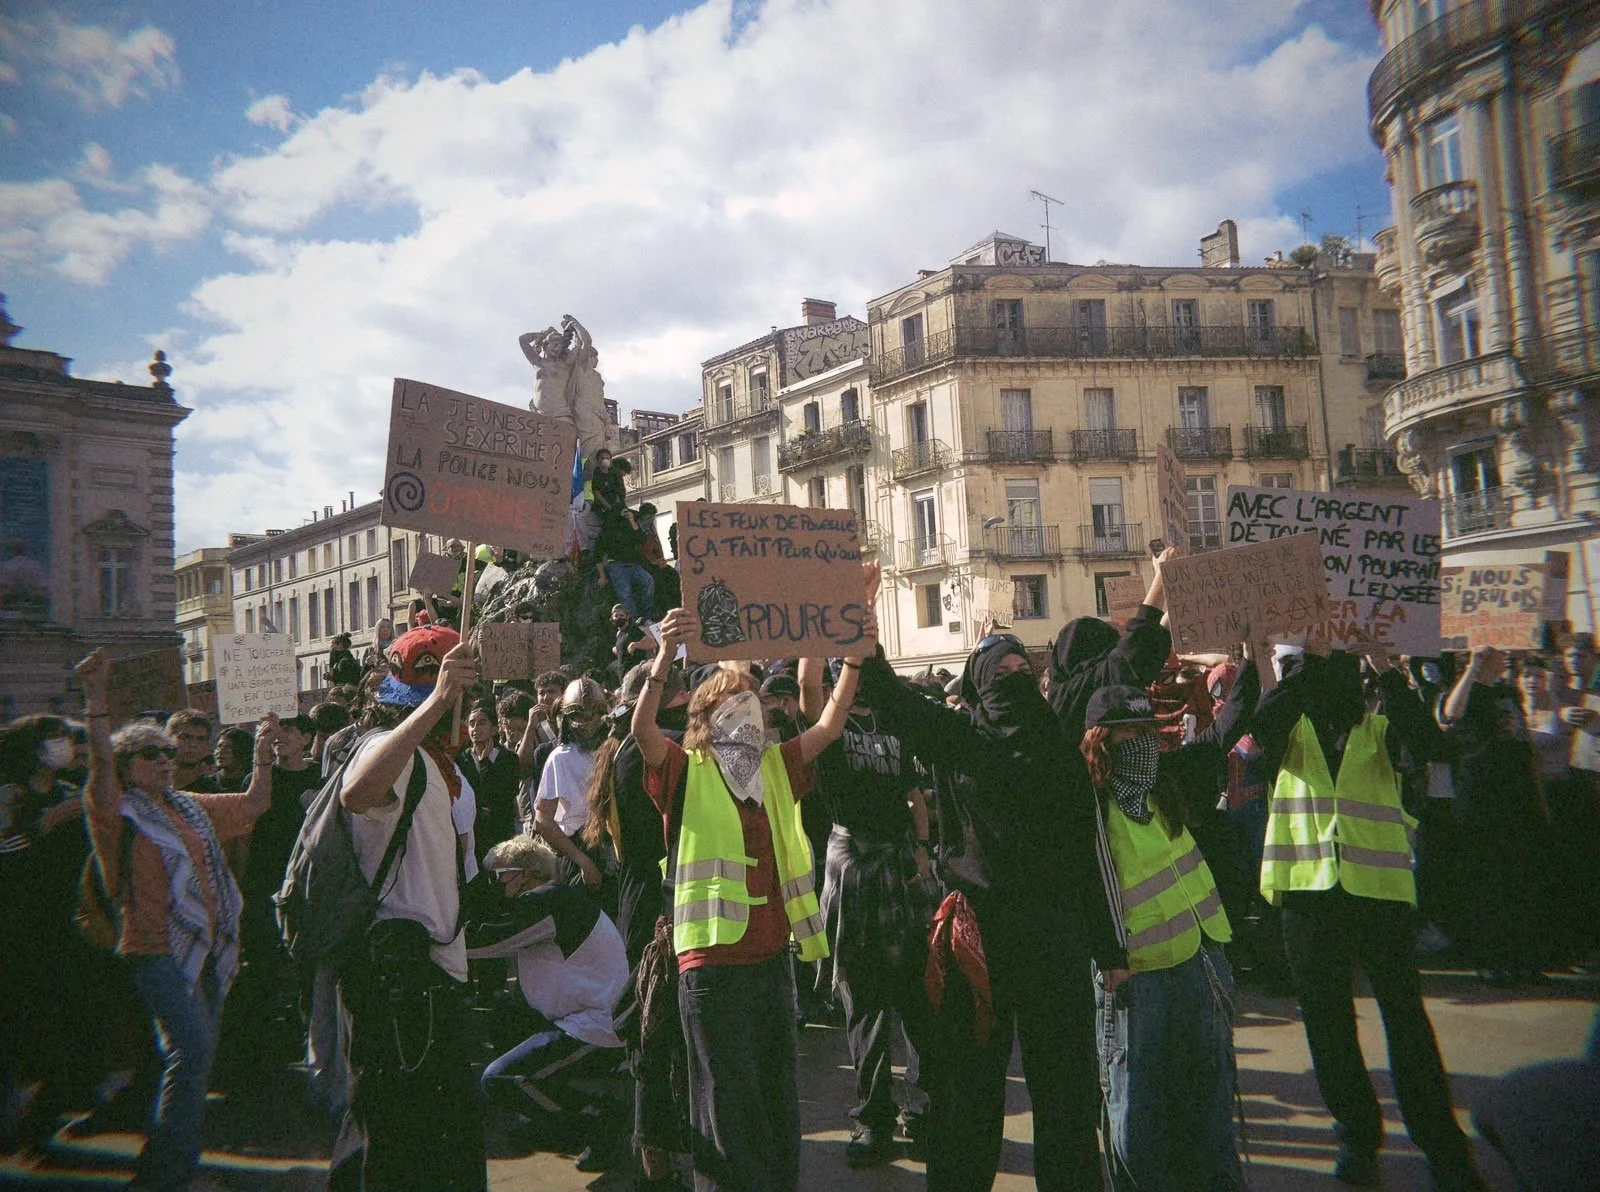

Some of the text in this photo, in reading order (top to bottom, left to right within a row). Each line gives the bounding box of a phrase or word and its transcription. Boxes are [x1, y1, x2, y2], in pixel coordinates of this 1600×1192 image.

[401, 383, 546, 437] LA JEUNESSE
[396, 444, 562, 495] LA POLICE NOUS
[687, 508, 721, 529] LES
[723, 511, 769, 531] FEUX
[774, 514, 798, 531] DE
[1227, 491, 1409, 526] AVEC L'ARGENT
[1364, 529, 1405, 552] PAR
[686, 535, 718, 574] ÇA
[720, 534, 772, 557] FAIT
[1164, 563, 1190, 583] UN
[1196, 558, 1229, 577] CRS
[1469, 569, 1531, 587] NOUS
[1178, 621, 1207, 646] EST
[223, 648, 241, 662] NE
[247, 648, 284, 660] TOUCHEZ
